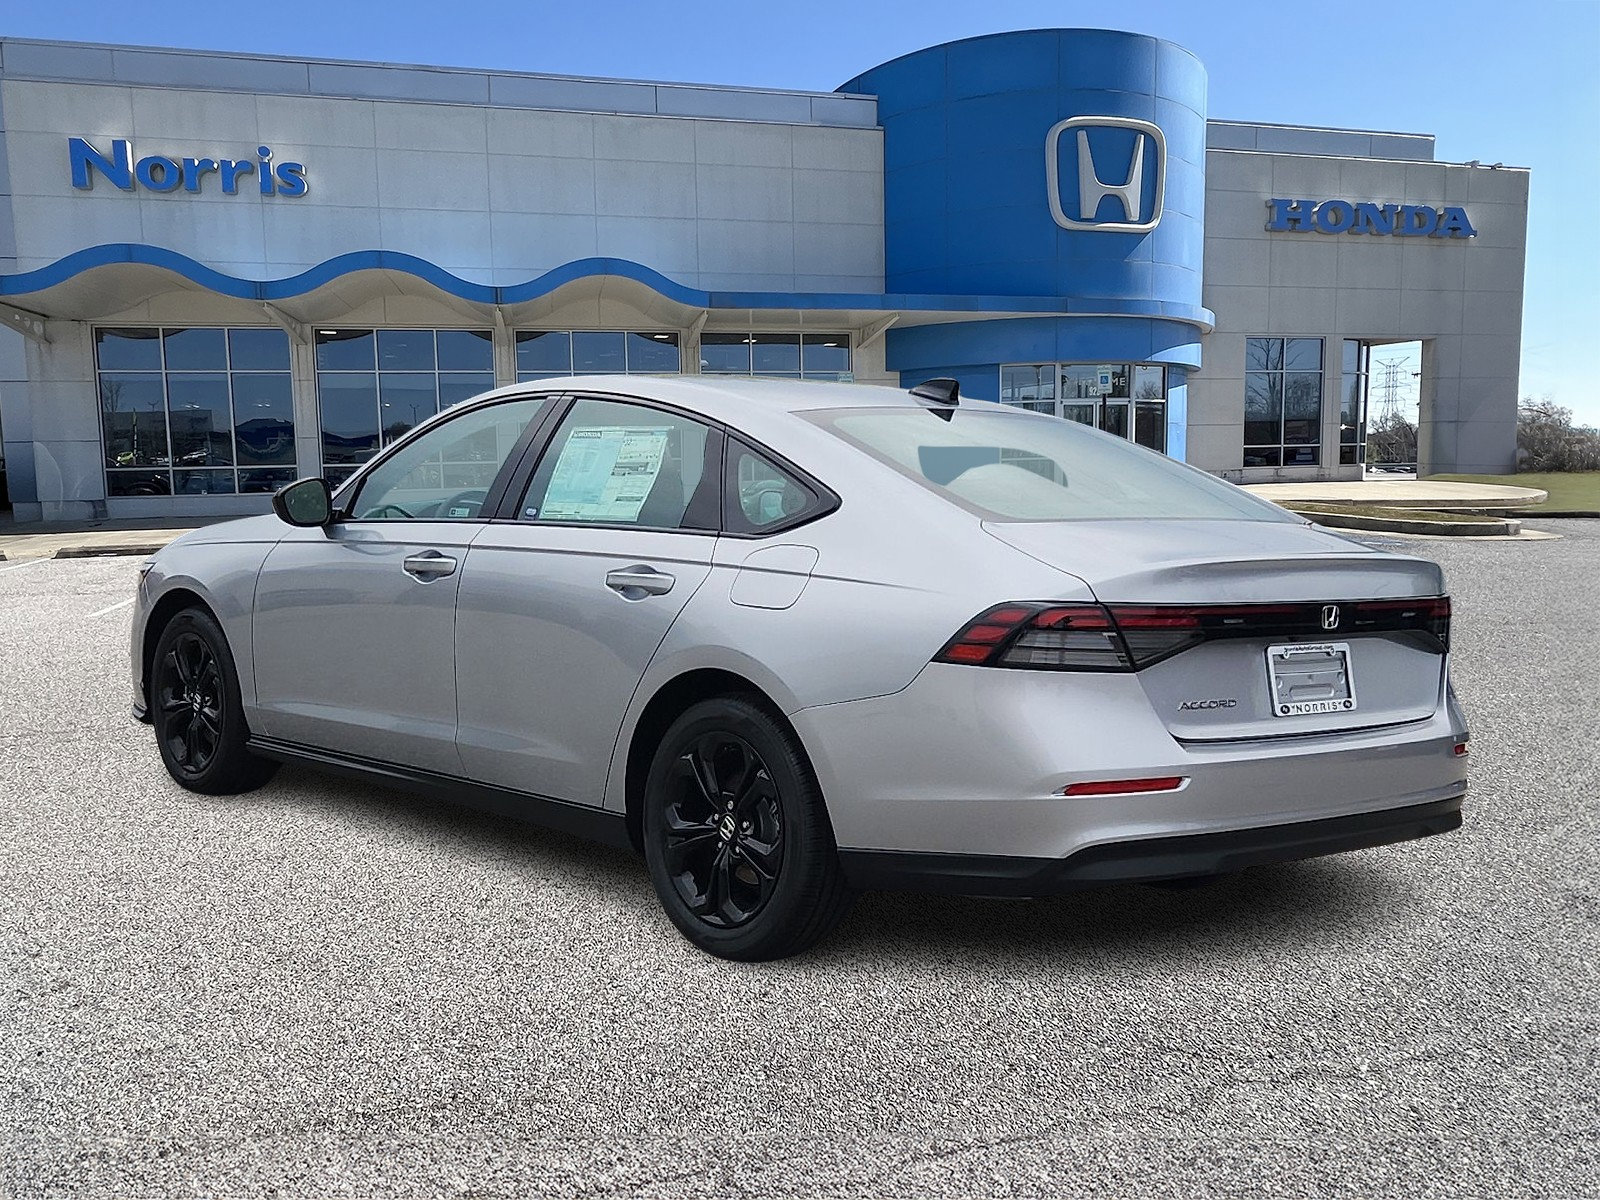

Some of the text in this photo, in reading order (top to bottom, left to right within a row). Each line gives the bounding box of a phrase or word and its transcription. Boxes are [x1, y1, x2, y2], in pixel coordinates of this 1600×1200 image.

[68, 137, 308, 197] Norris
[1265, 198, 1478, 239] HONDA
[1177, 699, 1237, 711] ACCORD
